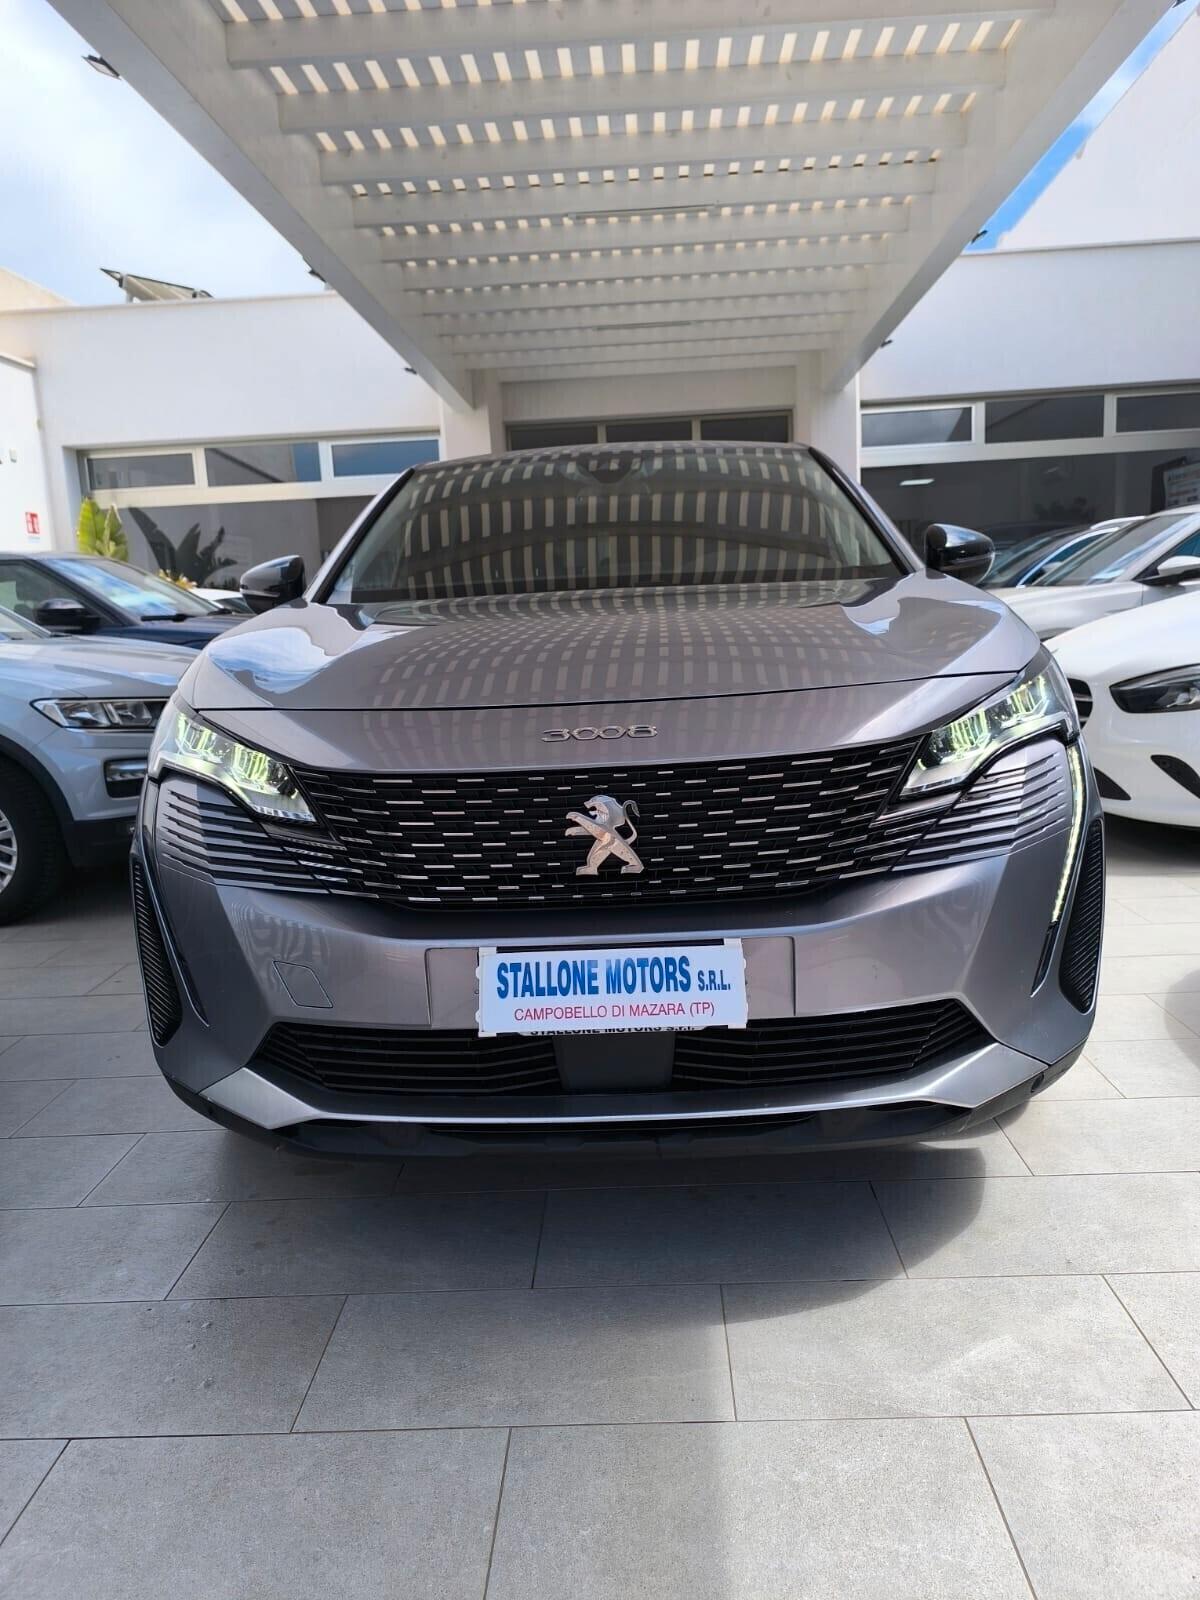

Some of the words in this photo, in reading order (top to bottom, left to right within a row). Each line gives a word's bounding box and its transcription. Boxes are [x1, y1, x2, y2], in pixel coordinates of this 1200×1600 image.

[541, 725, 658, 742] 3008
[496, 960, 599, 999] STALLONE
[605, 956, 691, 994] MOTORS
[697, 969, 731, 991] S.R.L.
[514, 1005, 607, 1021] CAMPOBELLO
[612, 1004, 625, 1017] DI
[629, 1002, 685, 1017] MAZARA
[689, 1001, 715, 1017] (TP)
